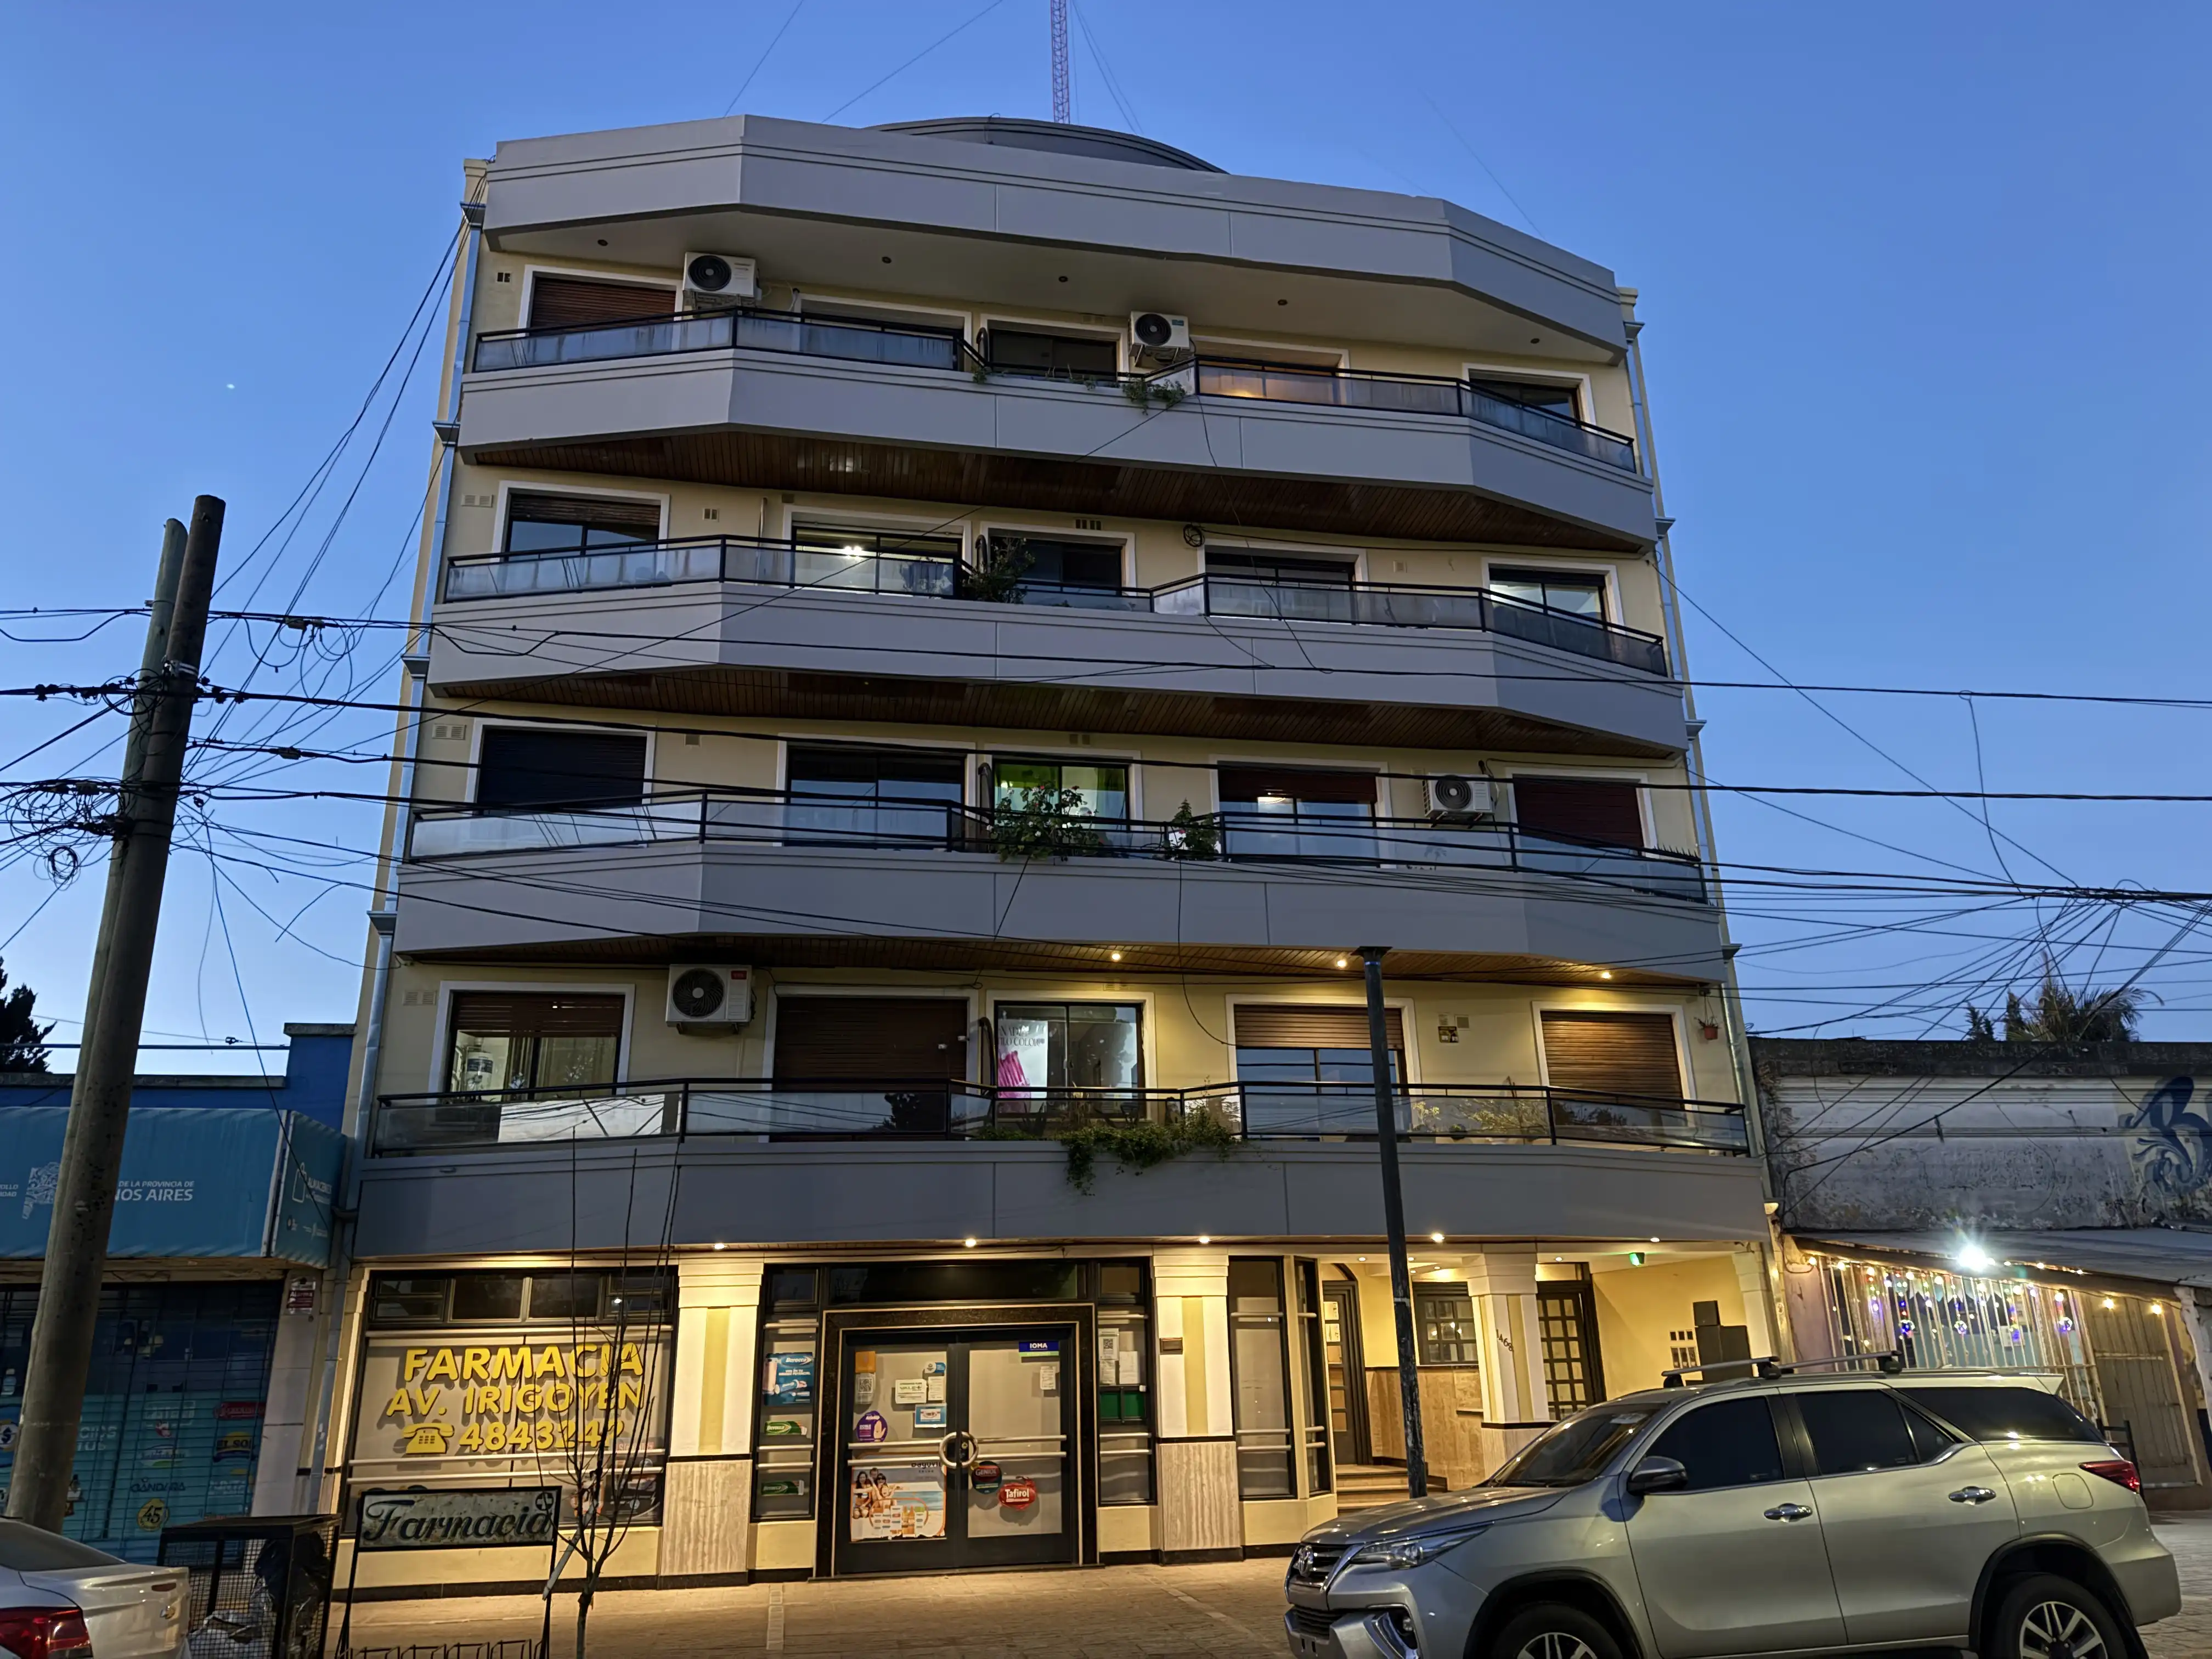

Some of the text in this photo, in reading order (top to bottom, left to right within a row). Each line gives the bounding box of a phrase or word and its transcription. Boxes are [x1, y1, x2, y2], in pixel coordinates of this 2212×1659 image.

[145, 1188, 194, 1201] AIRES
[1496, 1329, 1515, 1352] 1468
[404, 1342, 644, 1382] FARMACIA
[386, 1378, 646, 1417] AV. IRIGOYEN
[459, 1419, 625, 1451] 4843242
[1005, 1487, 1030, 1498] Tafirol
[363, 1499, 552, 1542] Farmacia
